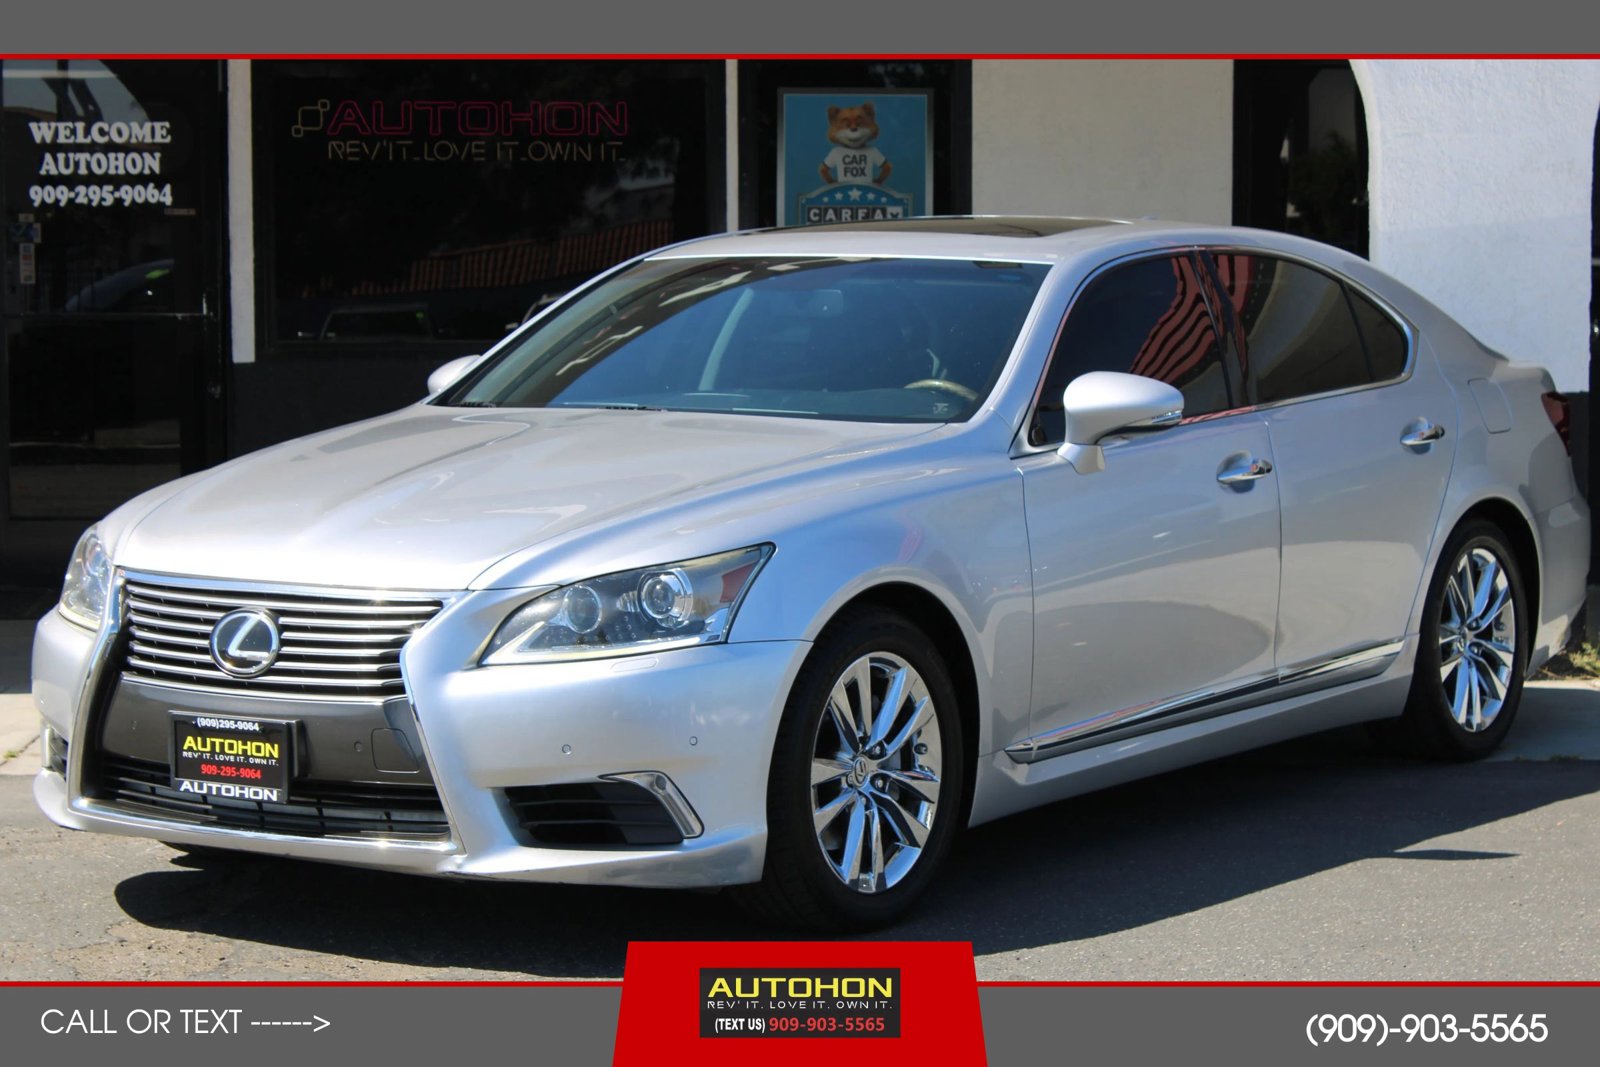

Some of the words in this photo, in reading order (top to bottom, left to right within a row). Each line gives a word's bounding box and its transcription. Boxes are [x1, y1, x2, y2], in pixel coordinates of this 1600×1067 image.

[327, 99, 628, 137] AUTOHON
[29, 121, 171, 143] WELCOME
[424, 140, 486, 161] LOVE
[528, 140, 592, 160] OWN
[842, 154, 868, 165] CAR
[39, 152, 161, 175] AUTOHON
[843, 166, 868, 177] FOX
[29, 183, 173, 207] 909-295-9064
[197, 717, 260, 731] (909)295-9064
[183, 735, 279, 759] AUTOHON
[201, 763, 261, 779] 909-295-9064
[180, 780, 278, 802] AUTOHON
